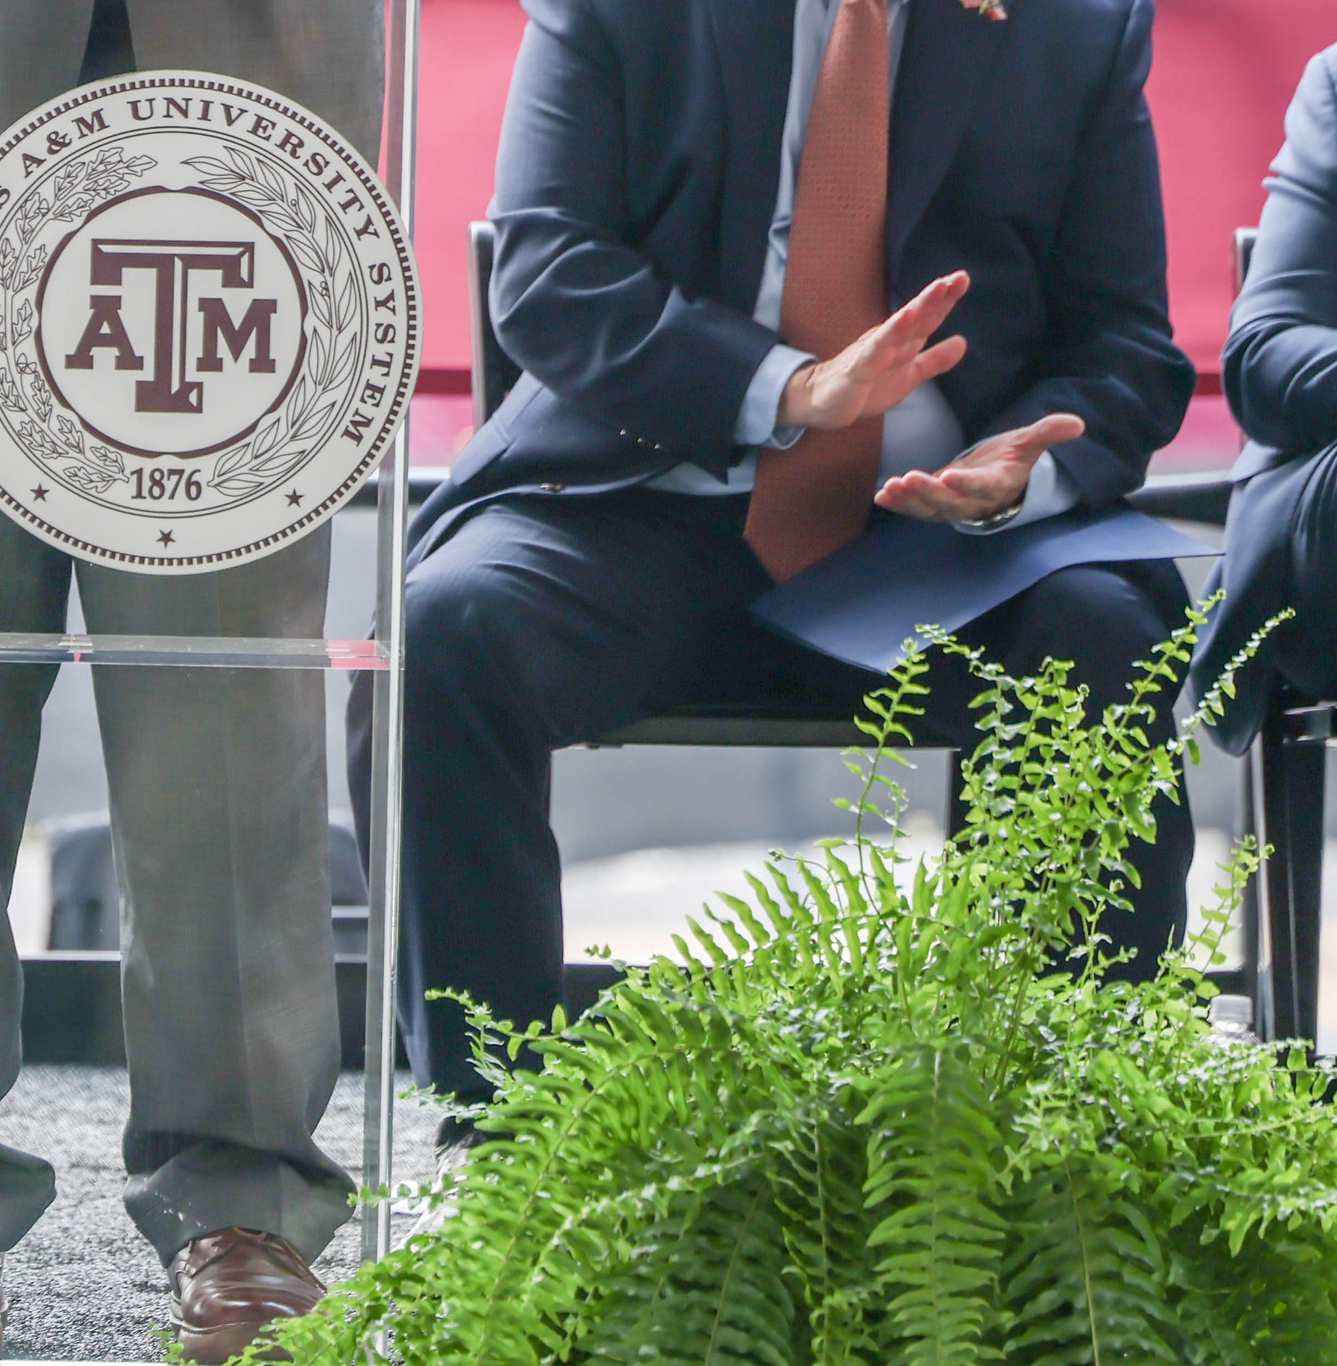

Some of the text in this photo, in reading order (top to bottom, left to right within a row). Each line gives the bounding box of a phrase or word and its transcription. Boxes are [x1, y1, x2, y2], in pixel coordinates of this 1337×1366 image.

[21, 106, 110, 178] A&M
[127, 96, 381, 241] UNIVERSITY
[341, 262, 397, 447] SYSTEM
[130, 467, 203, 502] 1876
